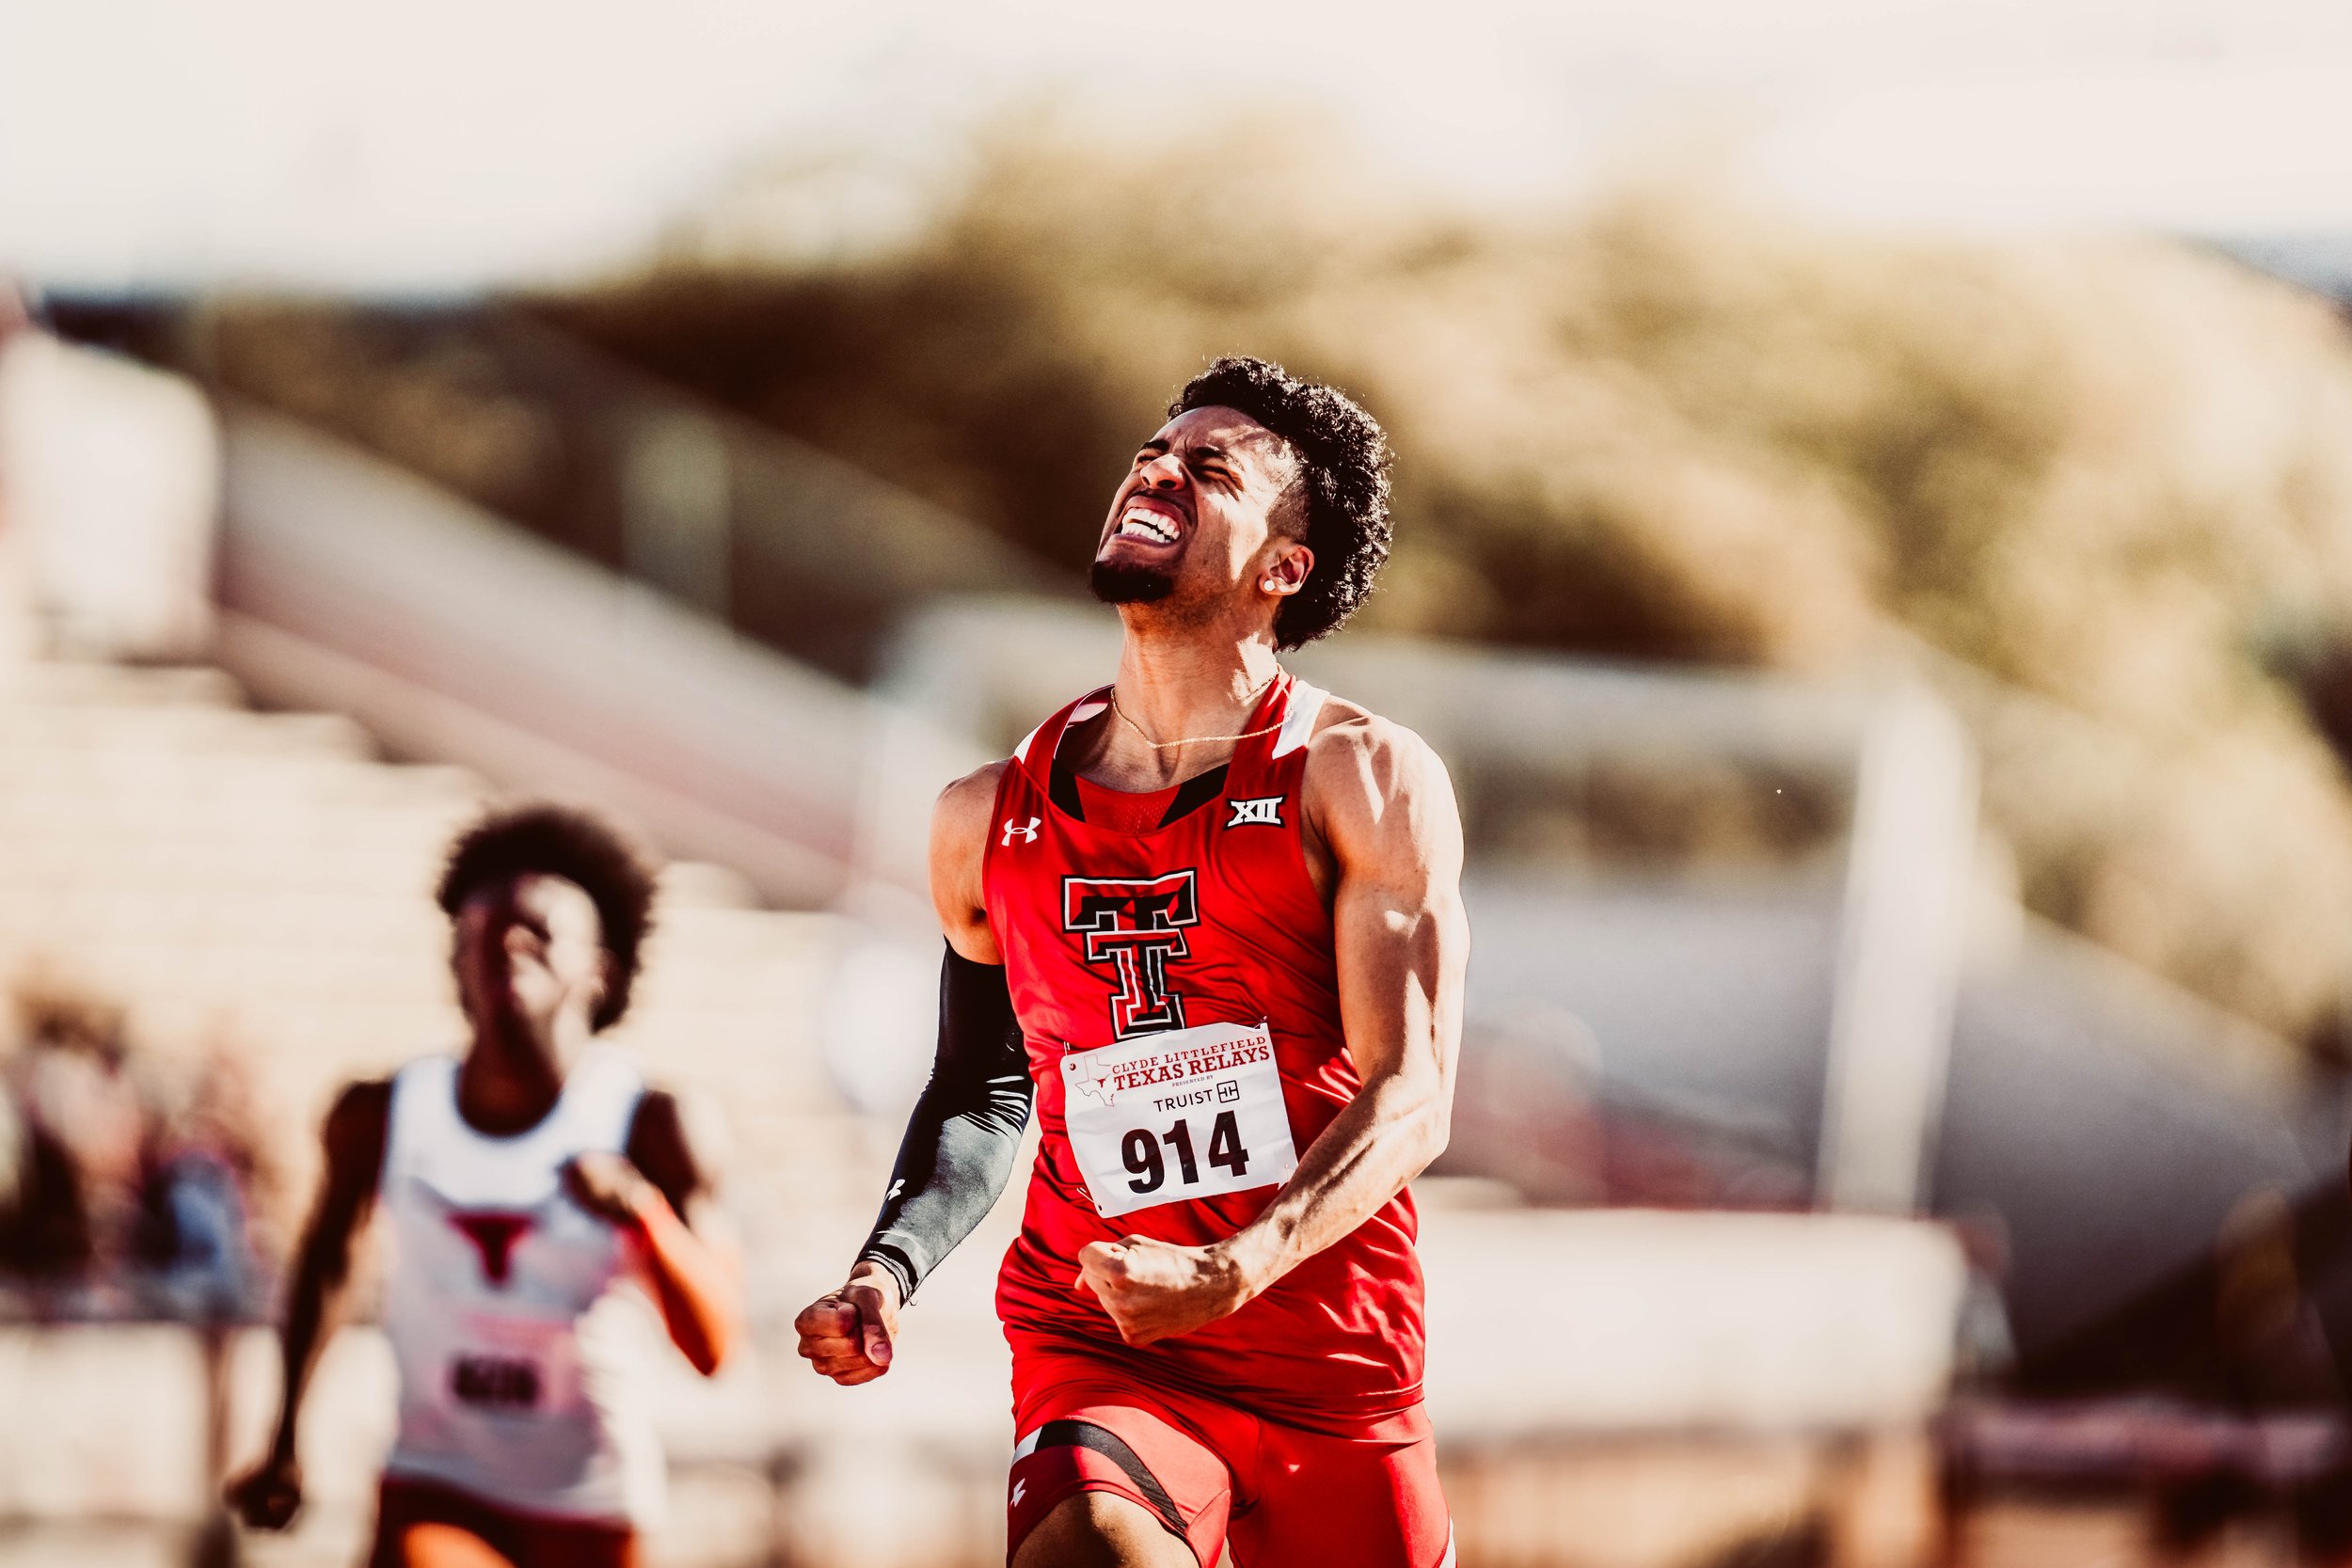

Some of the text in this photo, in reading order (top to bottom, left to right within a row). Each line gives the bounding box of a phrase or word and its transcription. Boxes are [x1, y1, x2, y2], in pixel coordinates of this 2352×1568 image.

[1112, 1036, 1266, 1074] CLYDE LITTLEFIELD
[1114, 1045, 1270, 1091] TEXAS RELAYS
[1153, 1089, 1213, 1112] TRUIST
[1172, 1076, 1205, 1087] PRESENTED
[1121, 1110, 1249, 1195] 914
